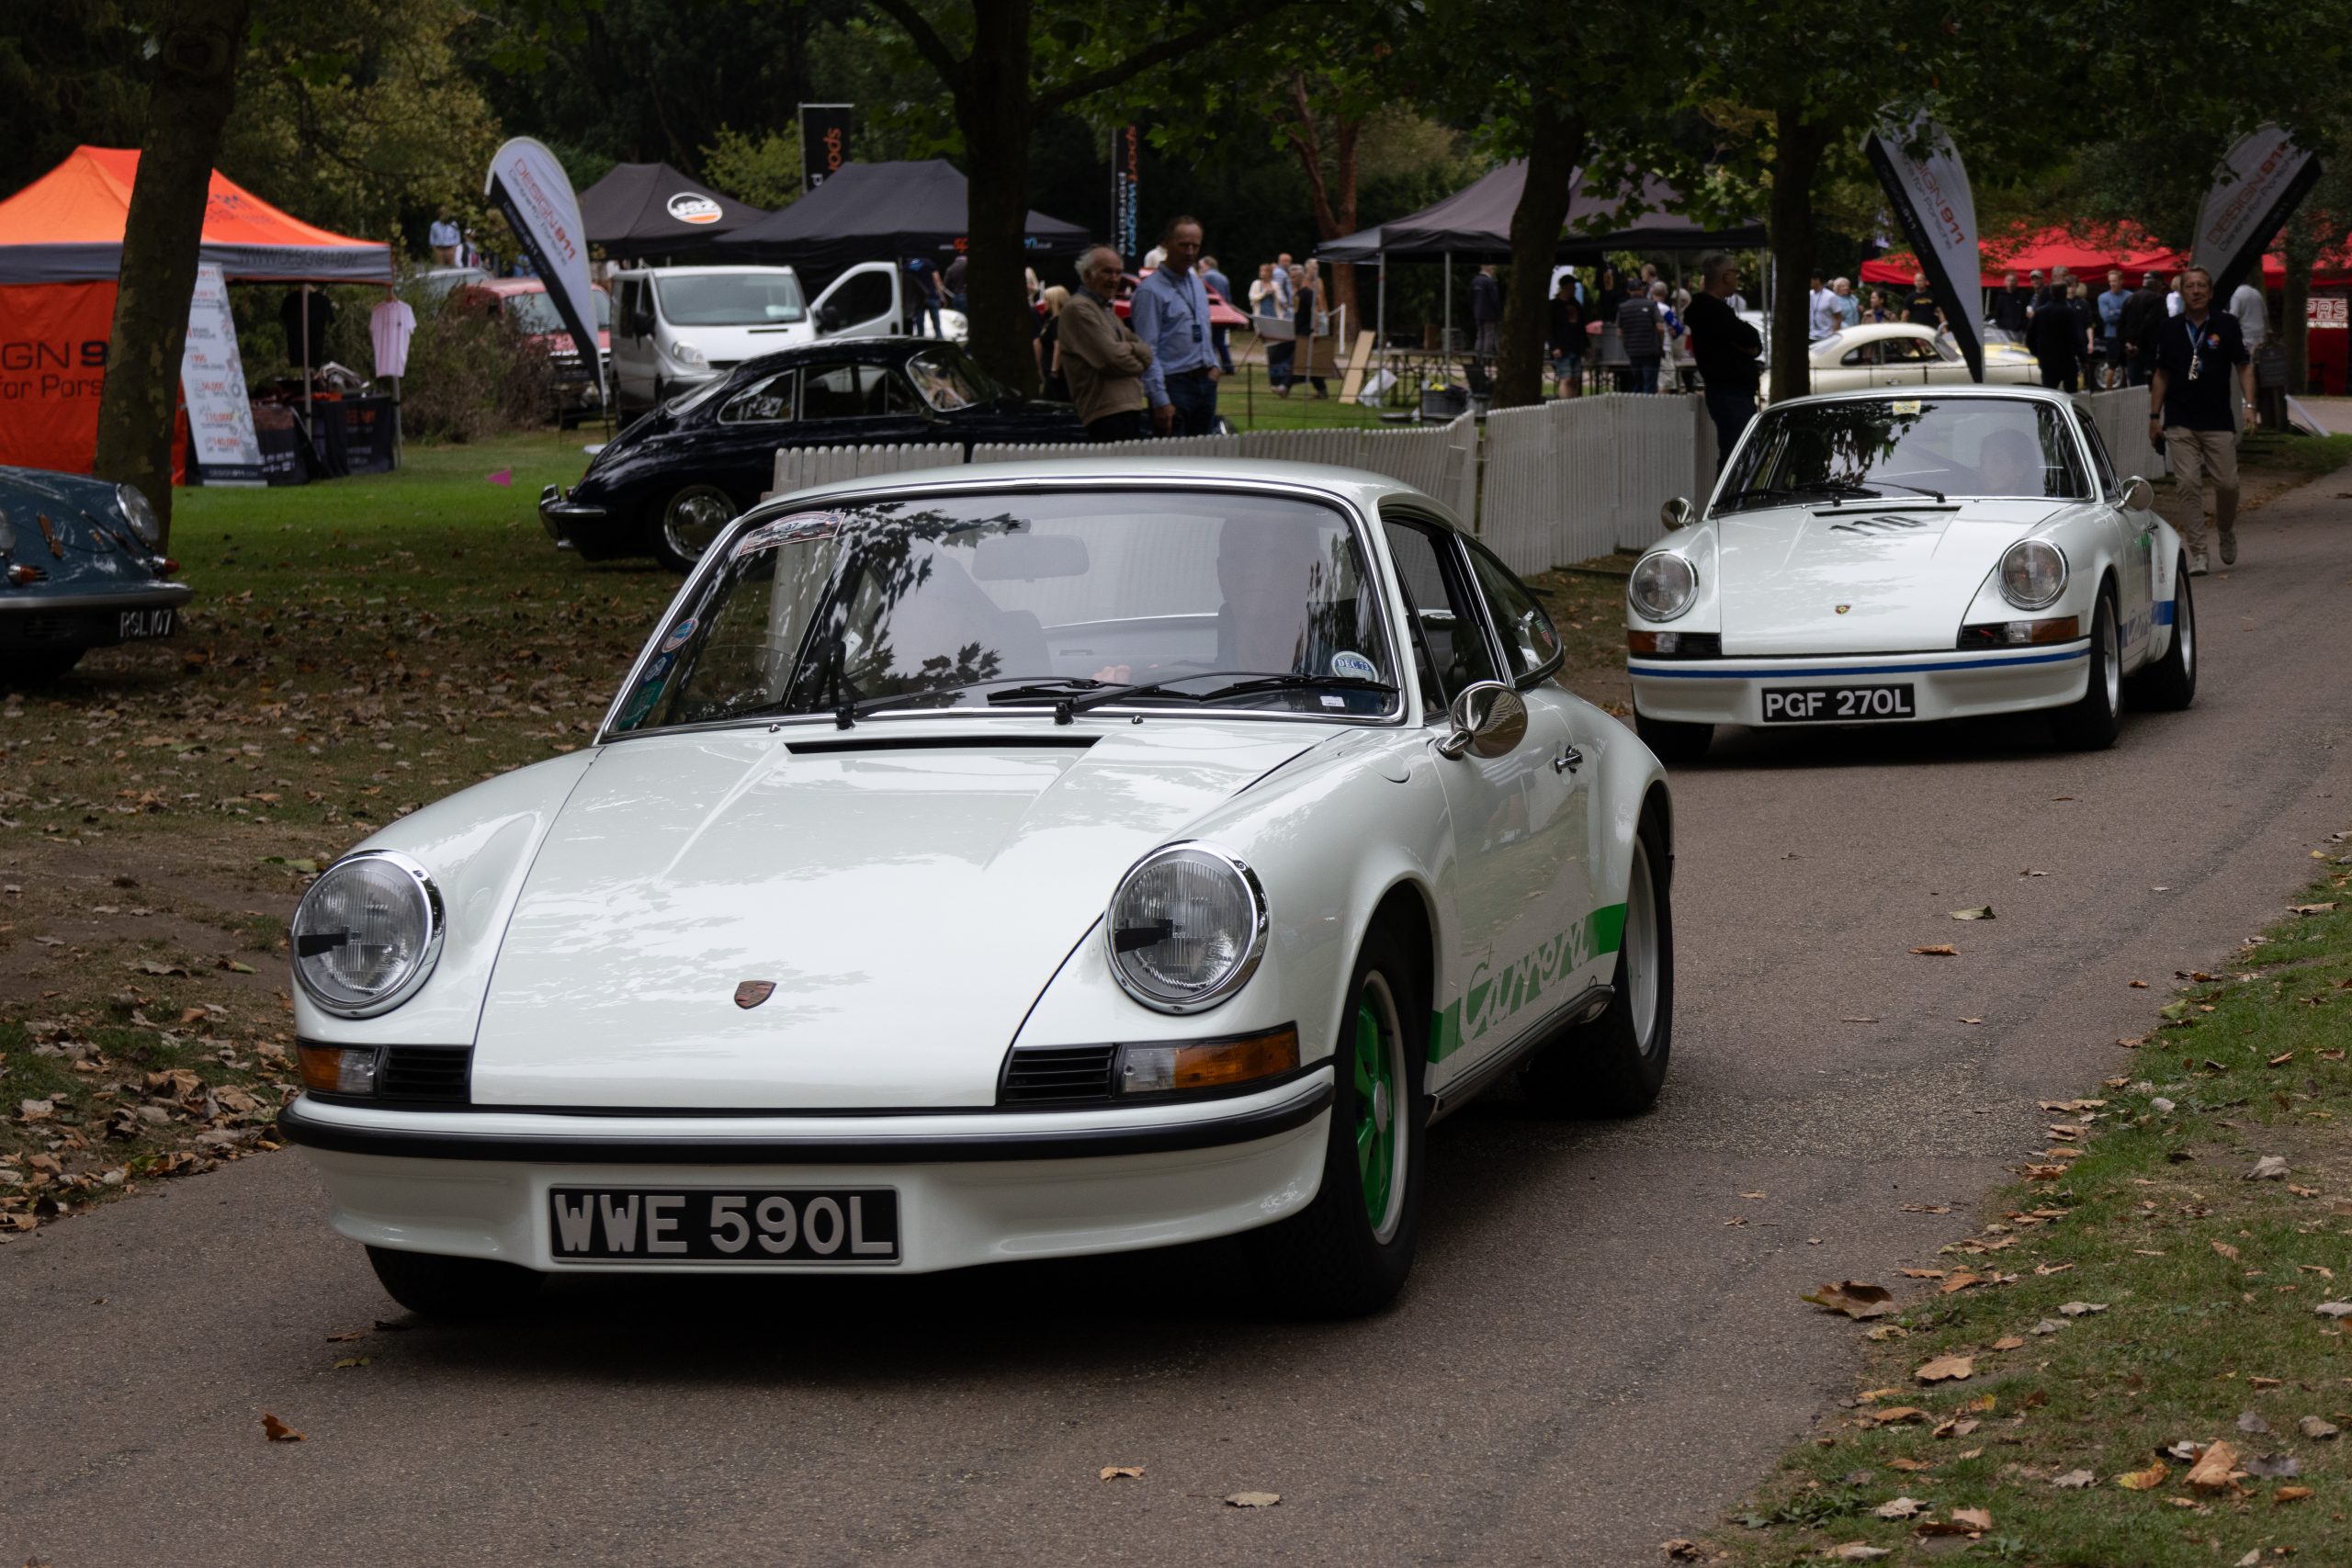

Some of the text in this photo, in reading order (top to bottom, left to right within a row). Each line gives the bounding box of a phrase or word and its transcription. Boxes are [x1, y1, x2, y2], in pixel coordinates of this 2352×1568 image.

[1337, 659, 1359, 669] DEC
[1766, 688, 1912, 718] PGF 270L
[555, 1194, 894, 1255] WWE 590L
